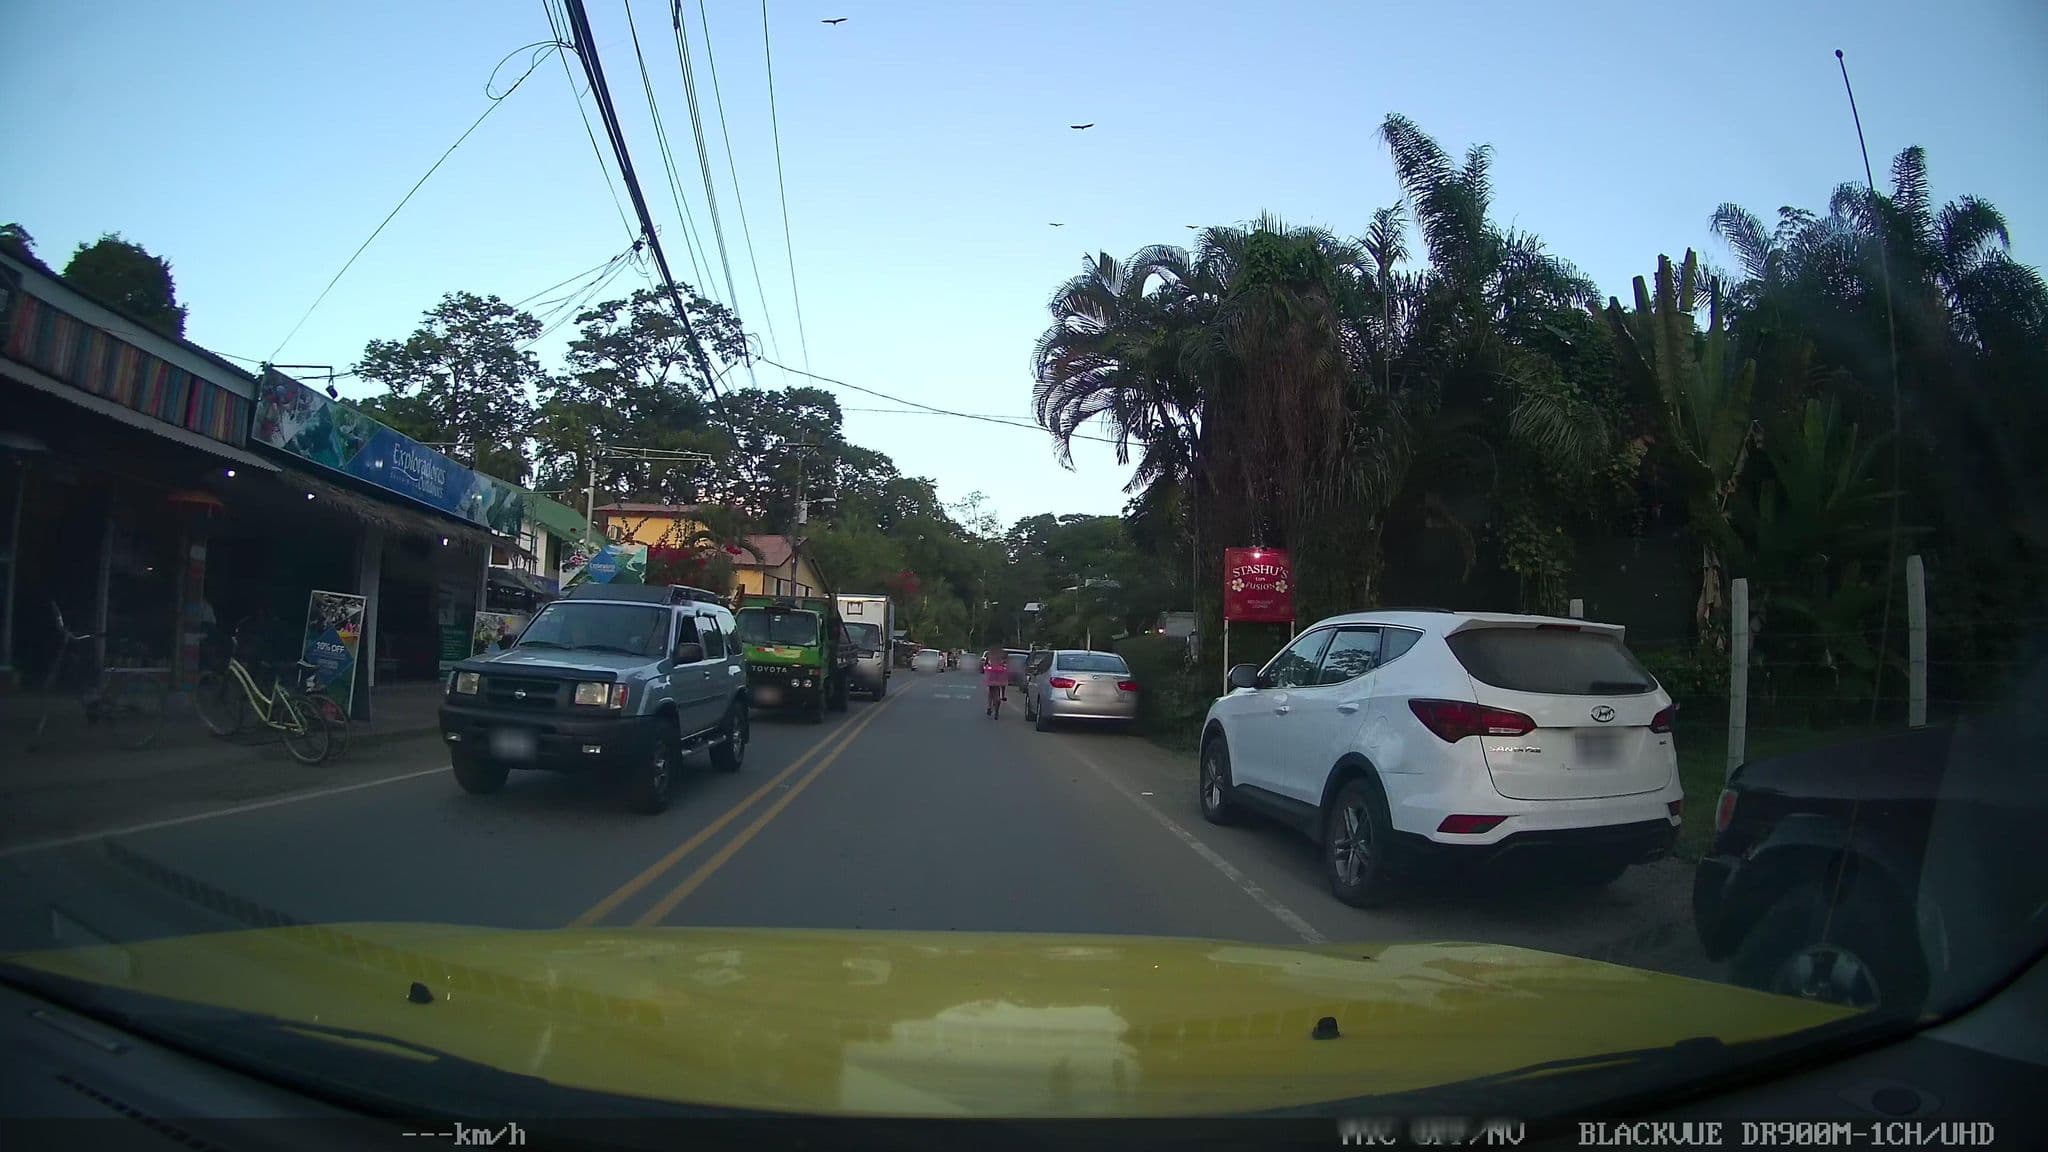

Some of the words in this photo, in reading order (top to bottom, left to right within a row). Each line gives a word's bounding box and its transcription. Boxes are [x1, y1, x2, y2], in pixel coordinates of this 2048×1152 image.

[1232, 564, 1289, 579] STASHU'S
[316, 641, 331, 652] 10%
[331, 644, 345, 655] OFF
[751, 664, 788, 673] TOYOTA
